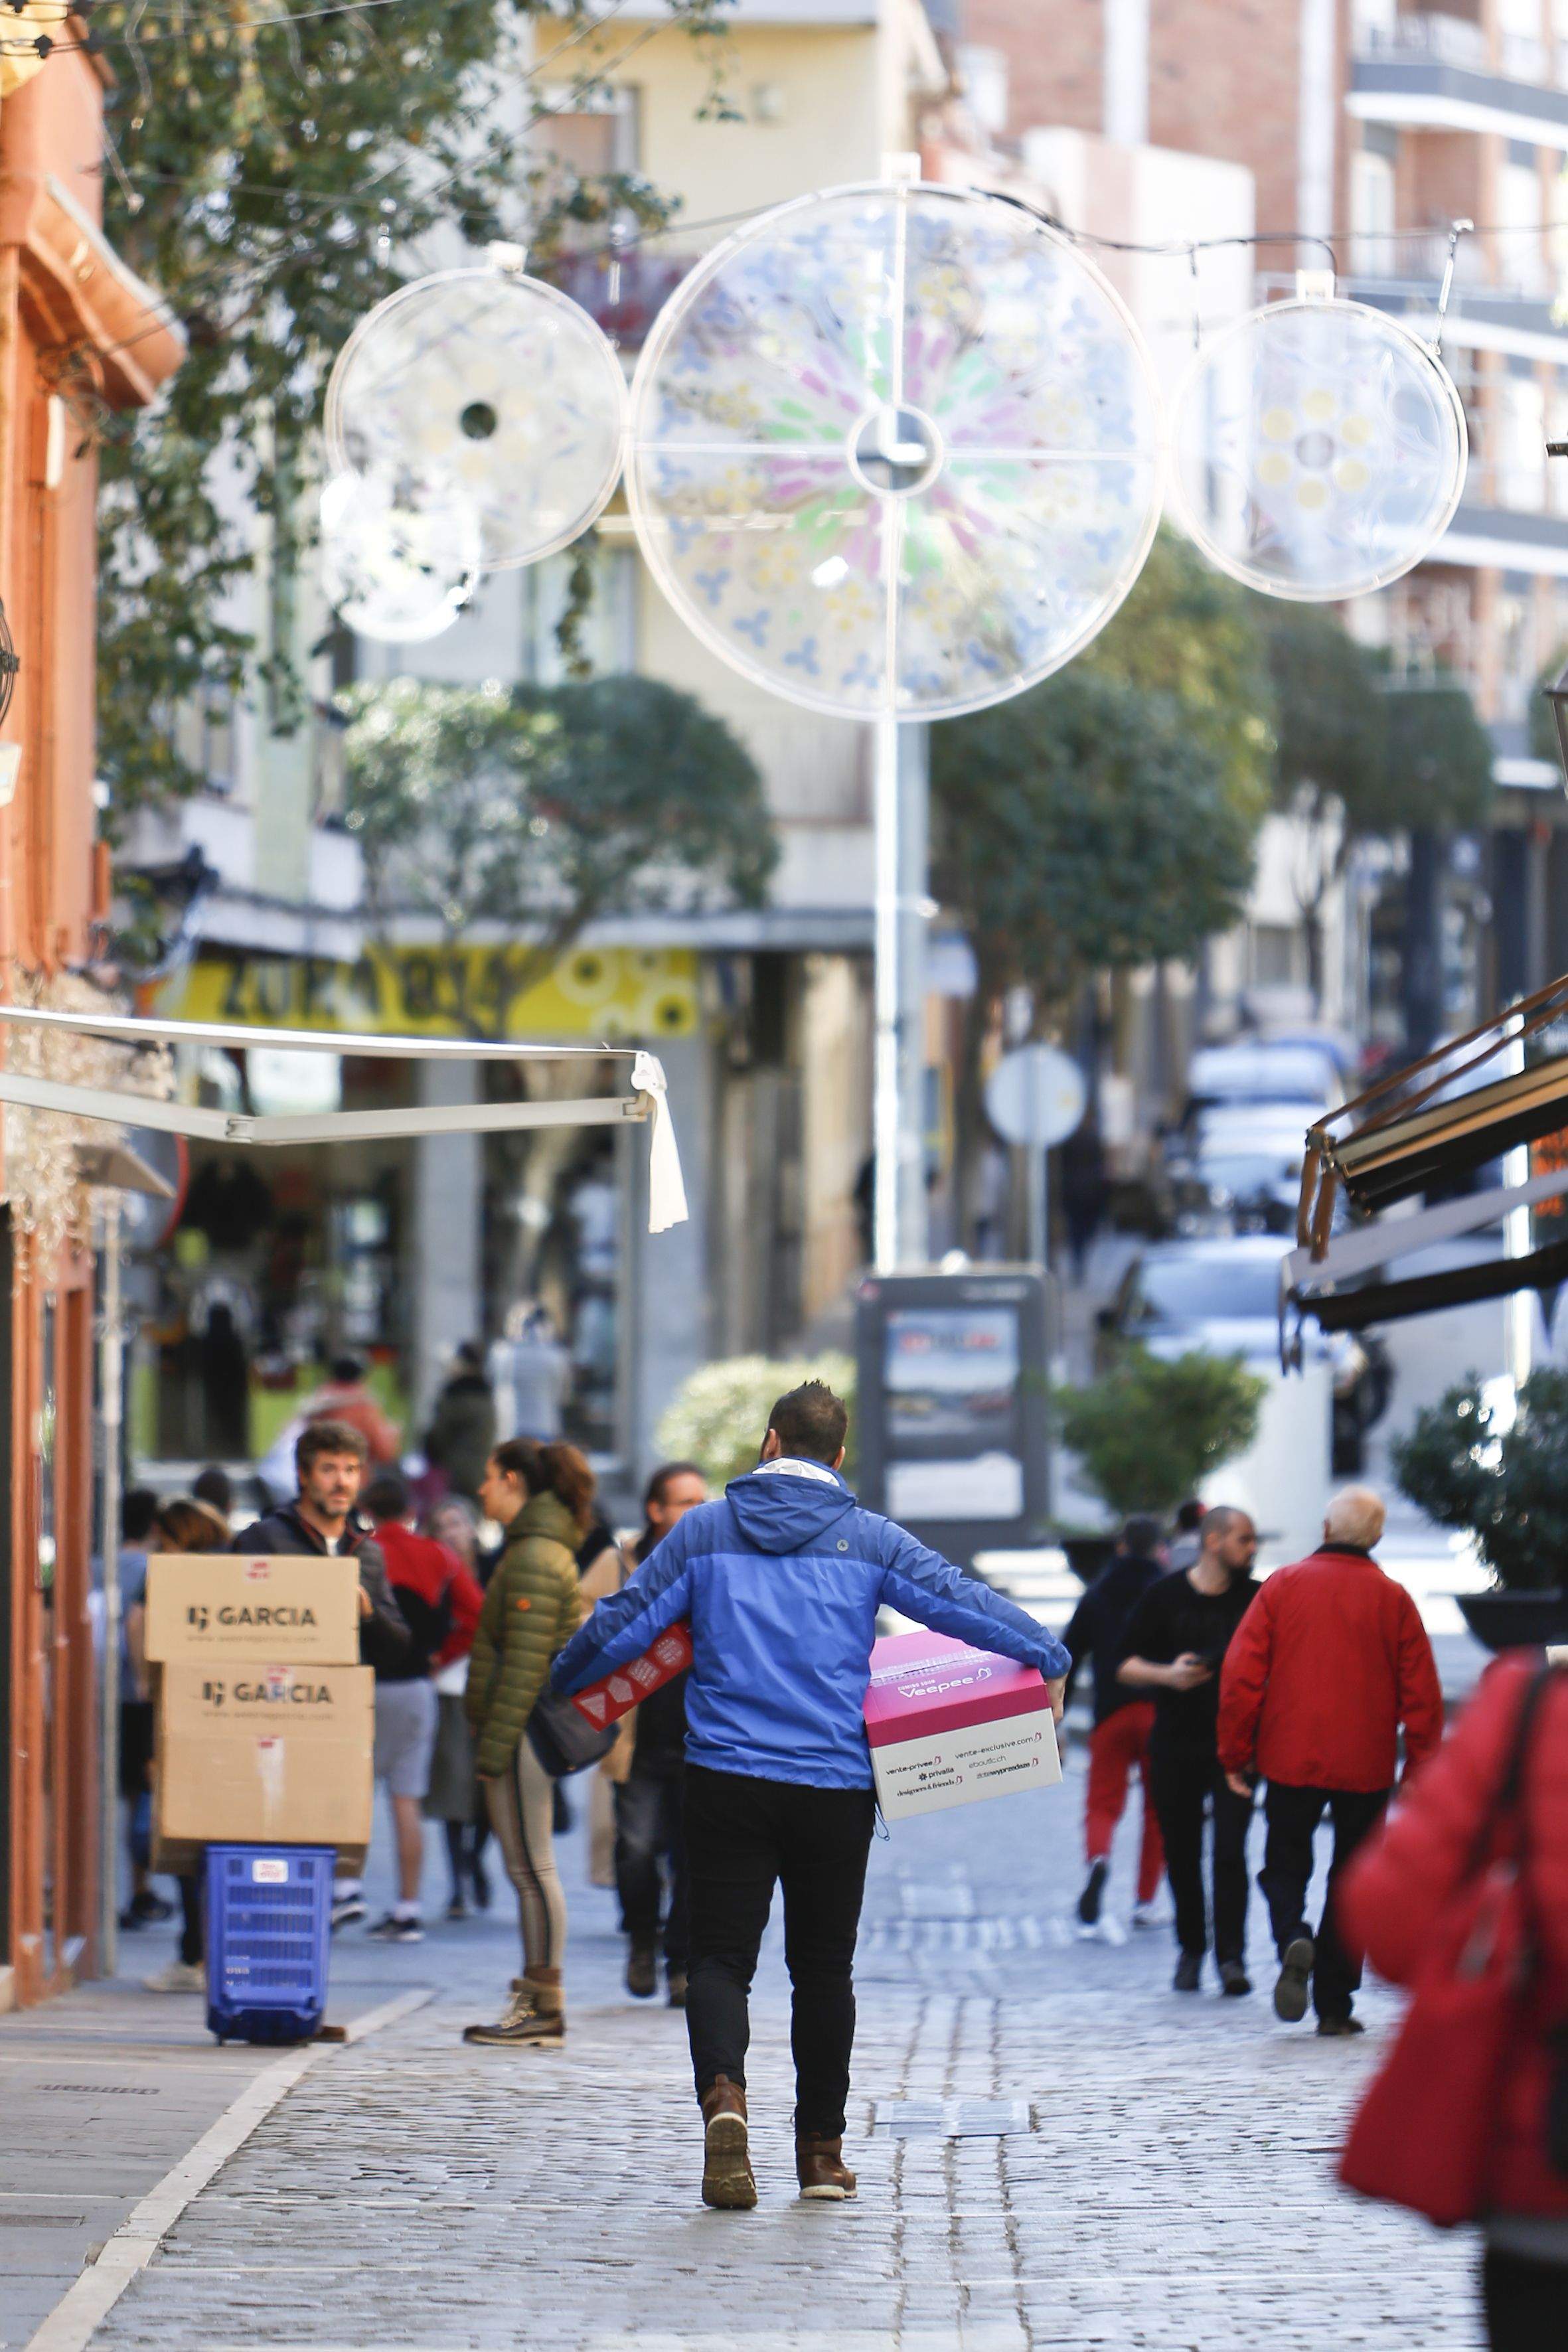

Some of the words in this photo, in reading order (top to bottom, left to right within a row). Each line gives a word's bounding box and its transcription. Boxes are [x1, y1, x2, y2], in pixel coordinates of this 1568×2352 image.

[218, 1606, 317, 1626] GARCIA
[900, 1677, 974, 1697] Veepee
[955, 1737, 1033, 1759] vente-exclusive.com
[886, 1761, 933, 1774] vente-privee
[929, 1767, 954, 1778] privalia
[897, 1785, 927, 1796] designers
[932, 1779, 955, 1789] friends
